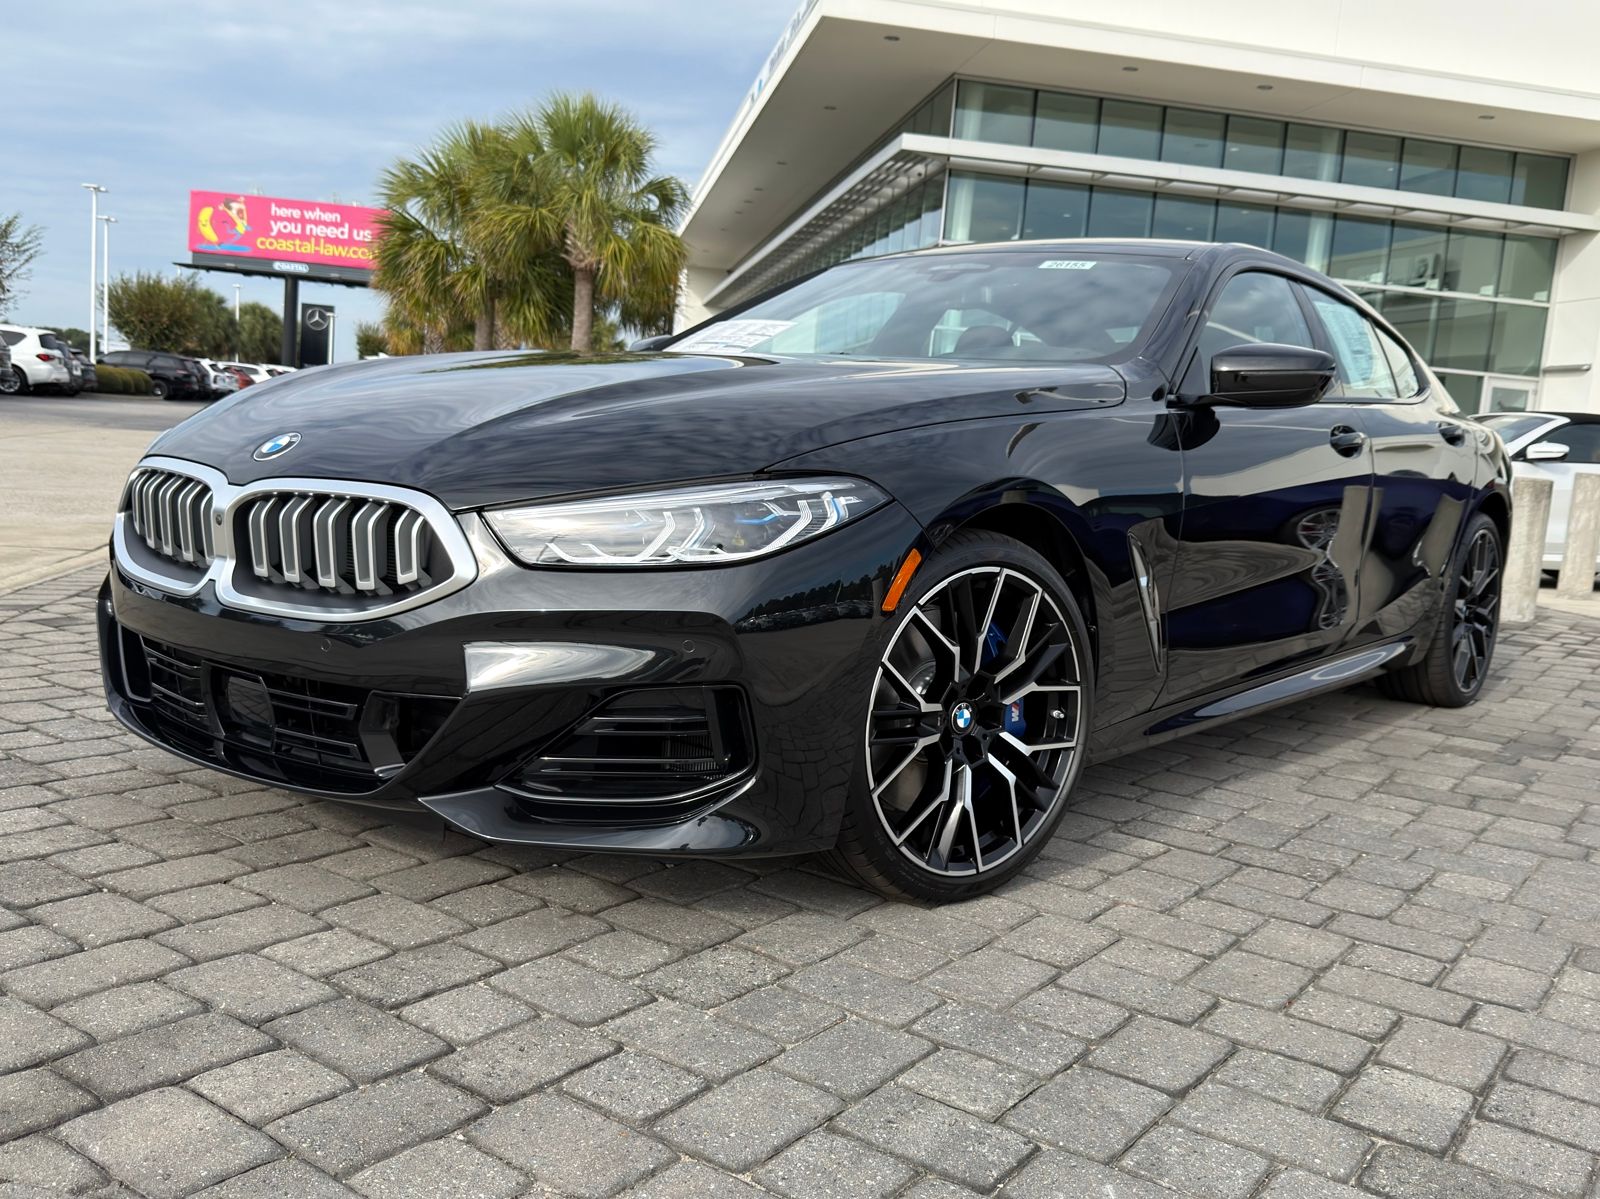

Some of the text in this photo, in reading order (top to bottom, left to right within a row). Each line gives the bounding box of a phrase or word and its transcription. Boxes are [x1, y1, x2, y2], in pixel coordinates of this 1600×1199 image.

[271, 202, 341, 223] here when
[270, 220, 372, 242] you need us
